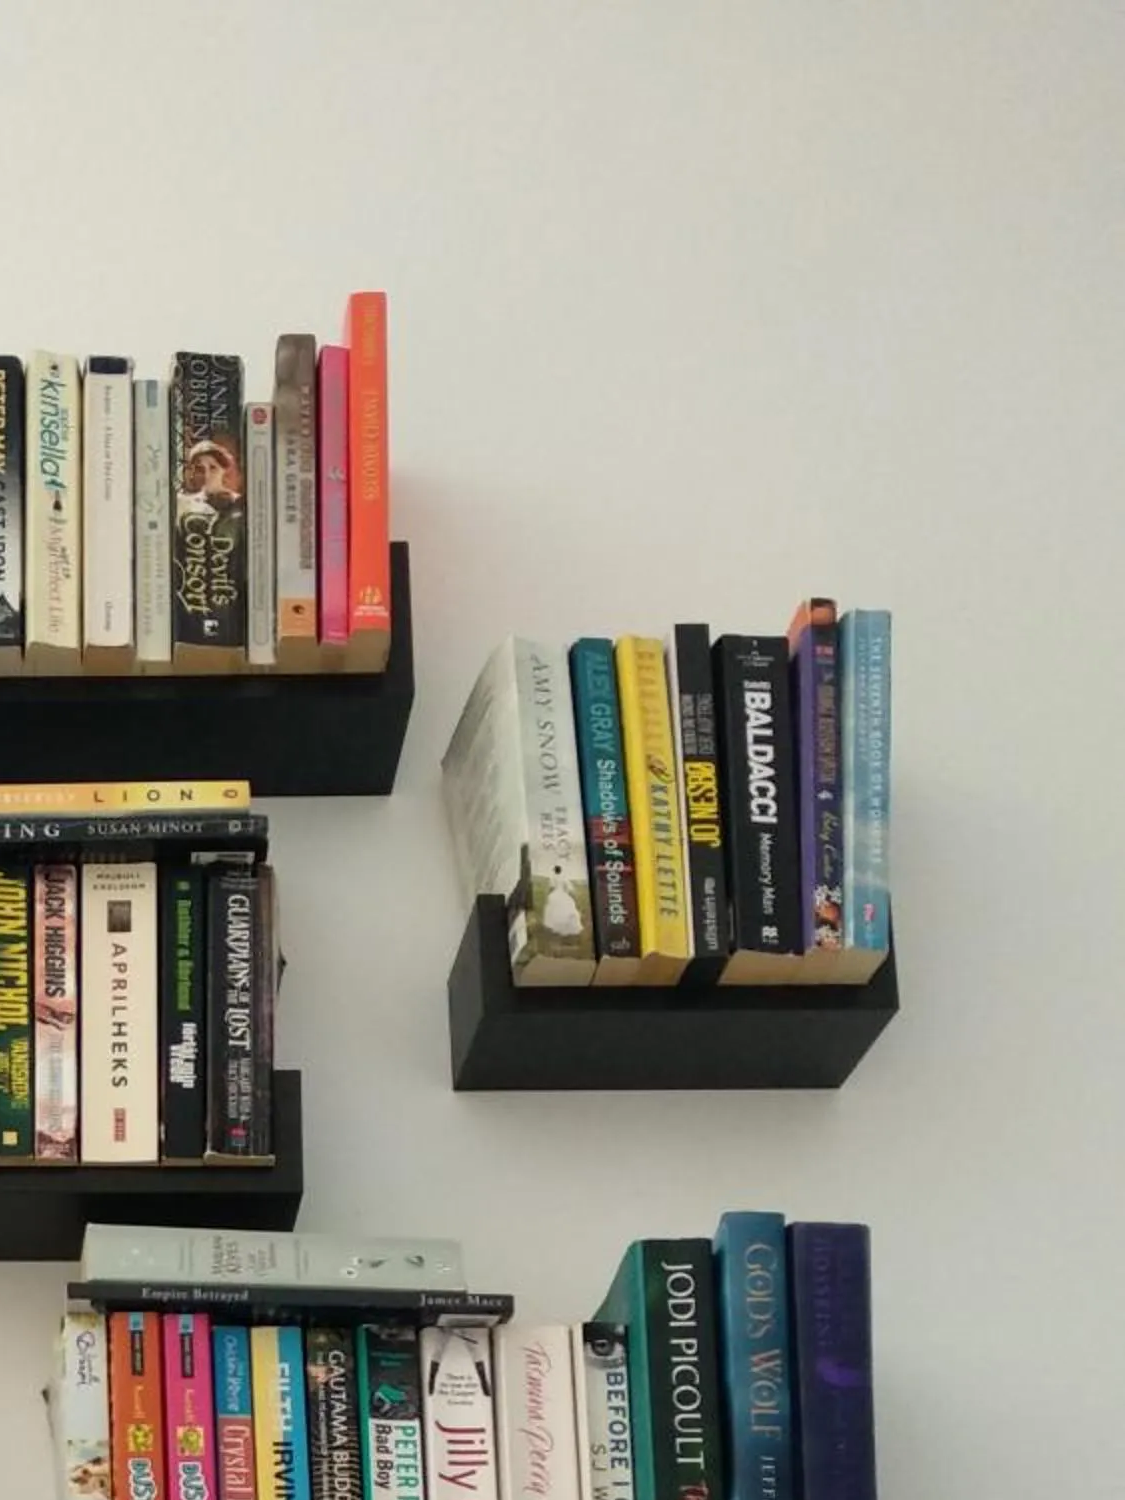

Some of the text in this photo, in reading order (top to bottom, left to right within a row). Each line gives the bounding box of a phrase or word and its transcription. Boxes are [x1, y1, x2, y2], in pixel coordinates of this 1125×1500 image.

[38, 377, 67, 477] kinsella
[531, 656, 561, 796] AMY SNOW
[589, 703, 614, 754] GRAY
[743, 693, 777, 825] BALDACCI
[87, 821, 141, 836] SUSAN
[93, 788, 193, 803] LION
[649, 784, 673, 848] KATHY
[596, 759, 628, 925] Shadows of Sounds
[690, 824, 721, 847] JO
[758, 832, 775, 915] Memory Man
[654, 856, 679, 918] LETTE
[43, 878, 67, 998] JACK HIGGINS
[225, 894, 251, 989] GUARDIANS
[110, 942, 128, 1089] APRILHEKS
[224, 1007, 251, 1051] LOST
[141, 1286, 249, 1302] Empire Betrayed
[327, 1351, 348, 1447] GAUTAMA
[661, 1261, 706, 1471] JODI PICOULT
[748, 1348, 784, 1440] WOLF
[220, 1425, 250, 1490] Crystal
[374, 1423, 393, 1490] Bad Boy
[393, 1424, 418, 1489] PETER
[434, 1420, 490, 1492] Jilly
[605, 1371, 629, 1470] BEFORE
